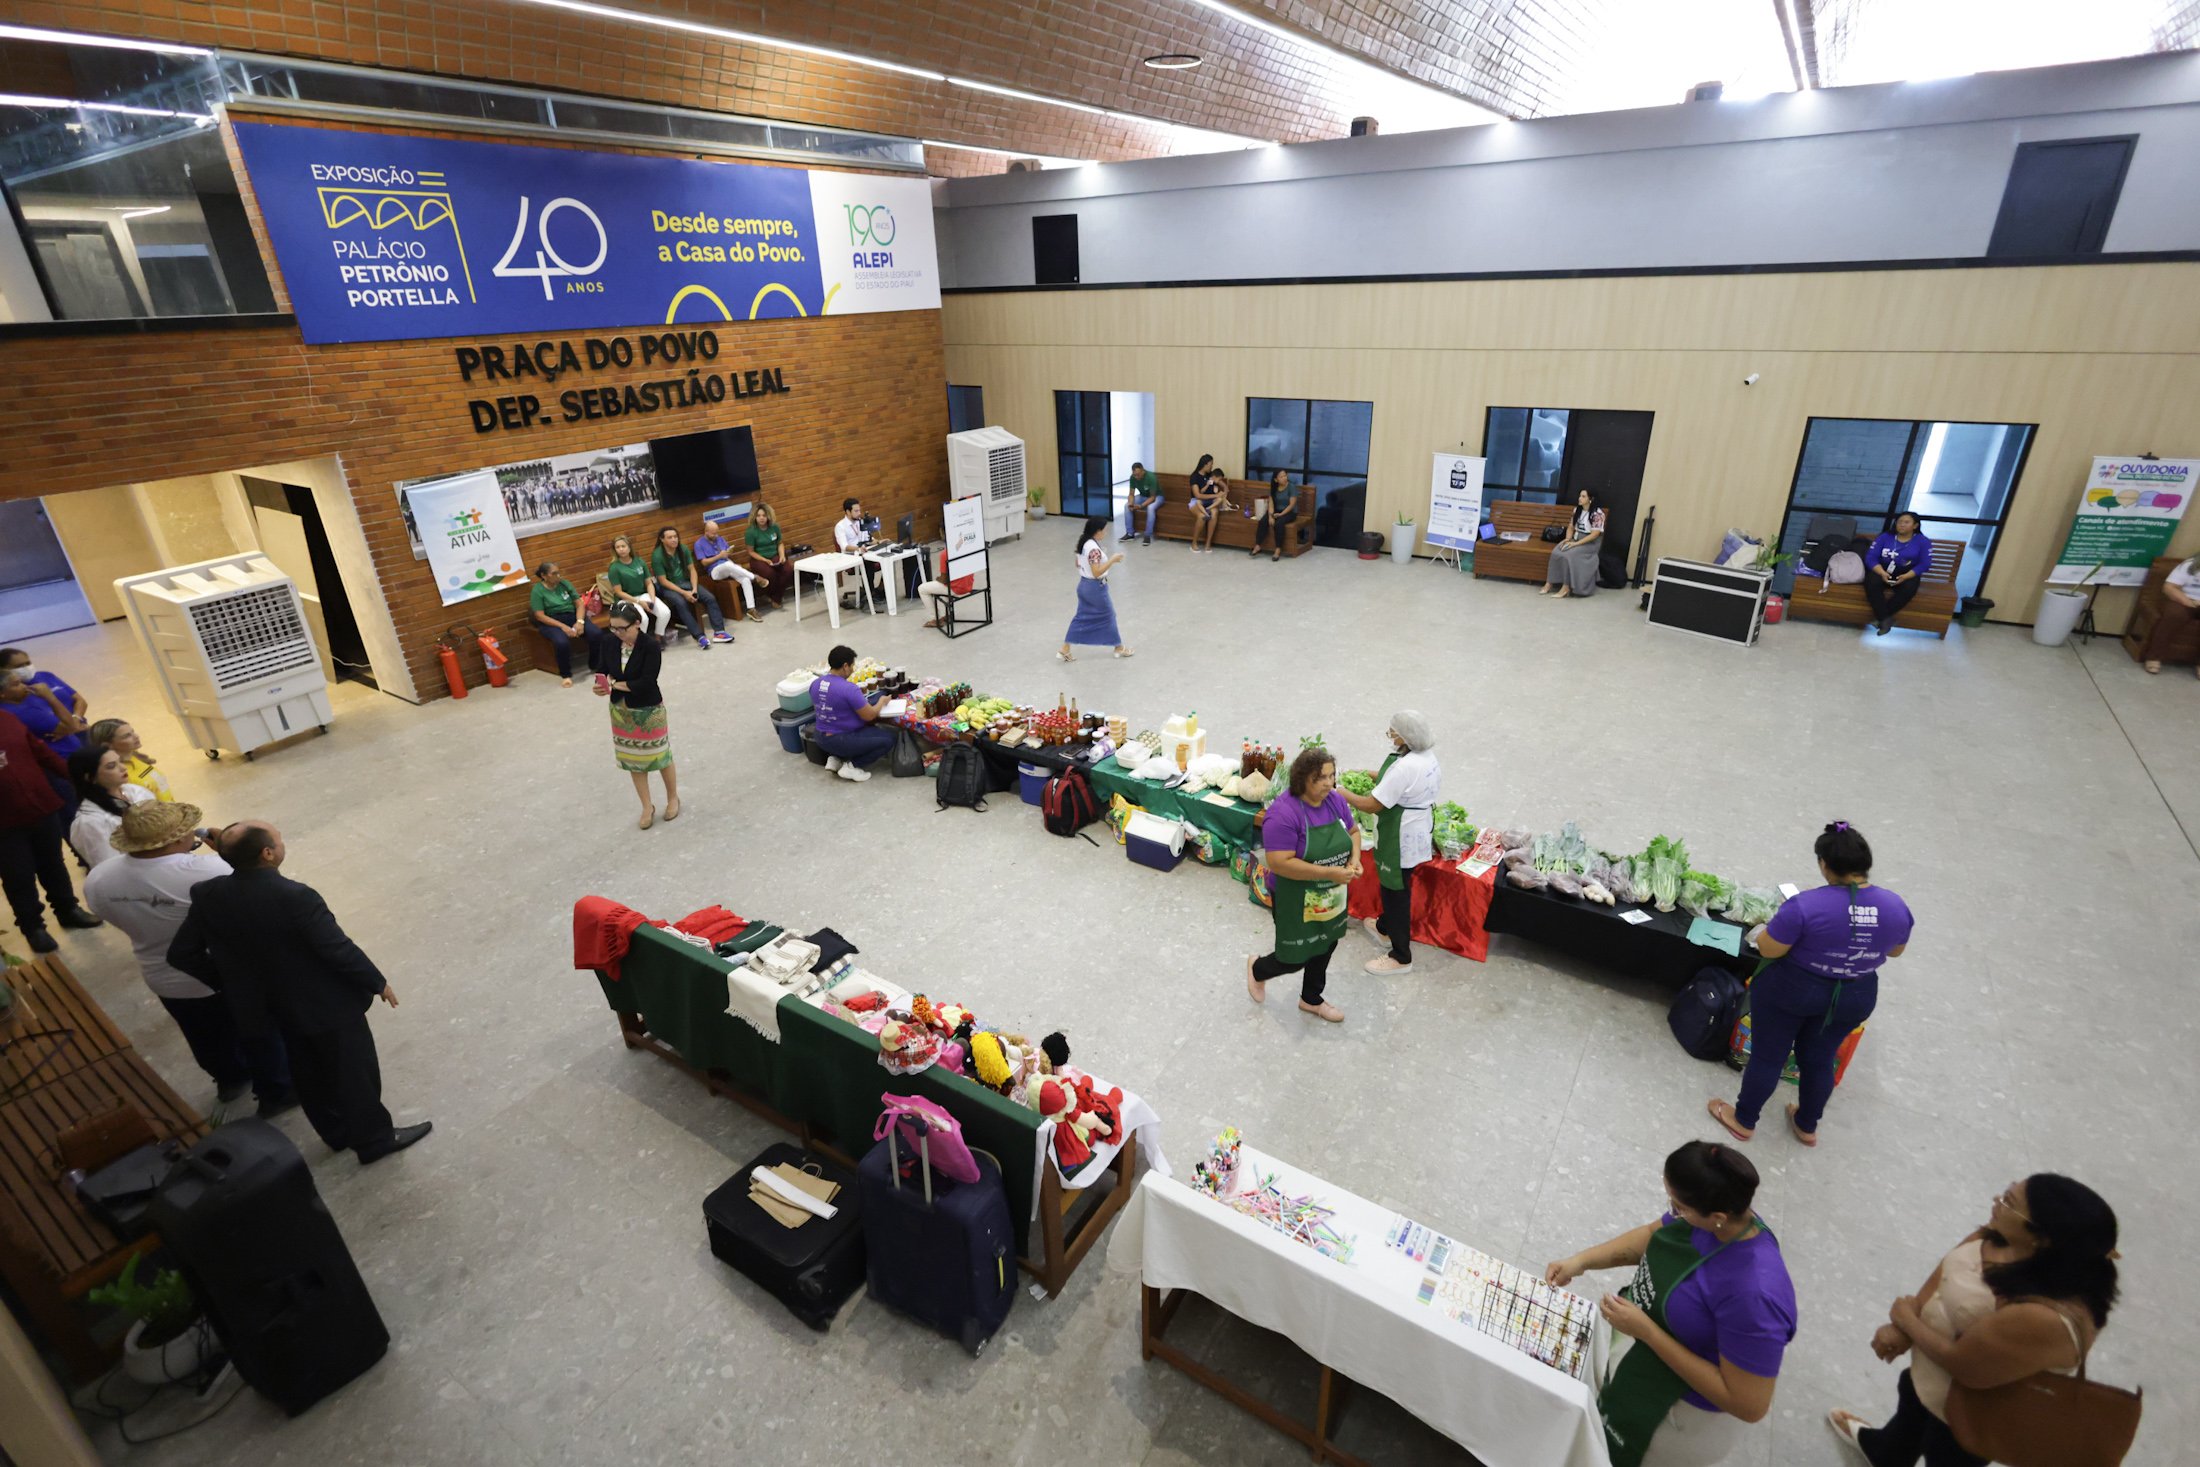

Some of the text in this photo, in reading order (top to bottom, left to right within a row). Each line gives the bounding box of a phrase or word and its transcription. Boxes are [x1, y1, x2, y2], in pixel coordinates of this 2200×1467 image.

[310, 164, 415, 186] EXPOSIÇÃO
[652, 210, 798, 240] Desde sempre,
[843, 203, 895, 247] 190
[332, 236, 426, 259] PALÁCIO
[492, 196, 608, 300] 40
[658, 241, 806, 262] a Casa do Povo.
[853, 252, 893, 268] ALEPI
[340, 261, 449, 284] PETRÔNIO
[854, 270, 922, 280] ASSEMBLEIA LEGISLATIVA
[566, 282, 605, 293] ANOS
[855, 281, 865, 290] DO
[867, 280, 889, 290] ESTADO
[890, 280, 900, 288] DO
[347, 287, 460, 307] PORTELLA
[455, 330, 719, 383] PRAÇA DO POVO
[468, 367, 791, 433] DEP. SEBASTIÃO LEAL
[2120, 464, 2189, 475] OUVIDORIA
[2116, 518, 2170, 527] atendimento
[451, 530, 491, 549] ATIVA
